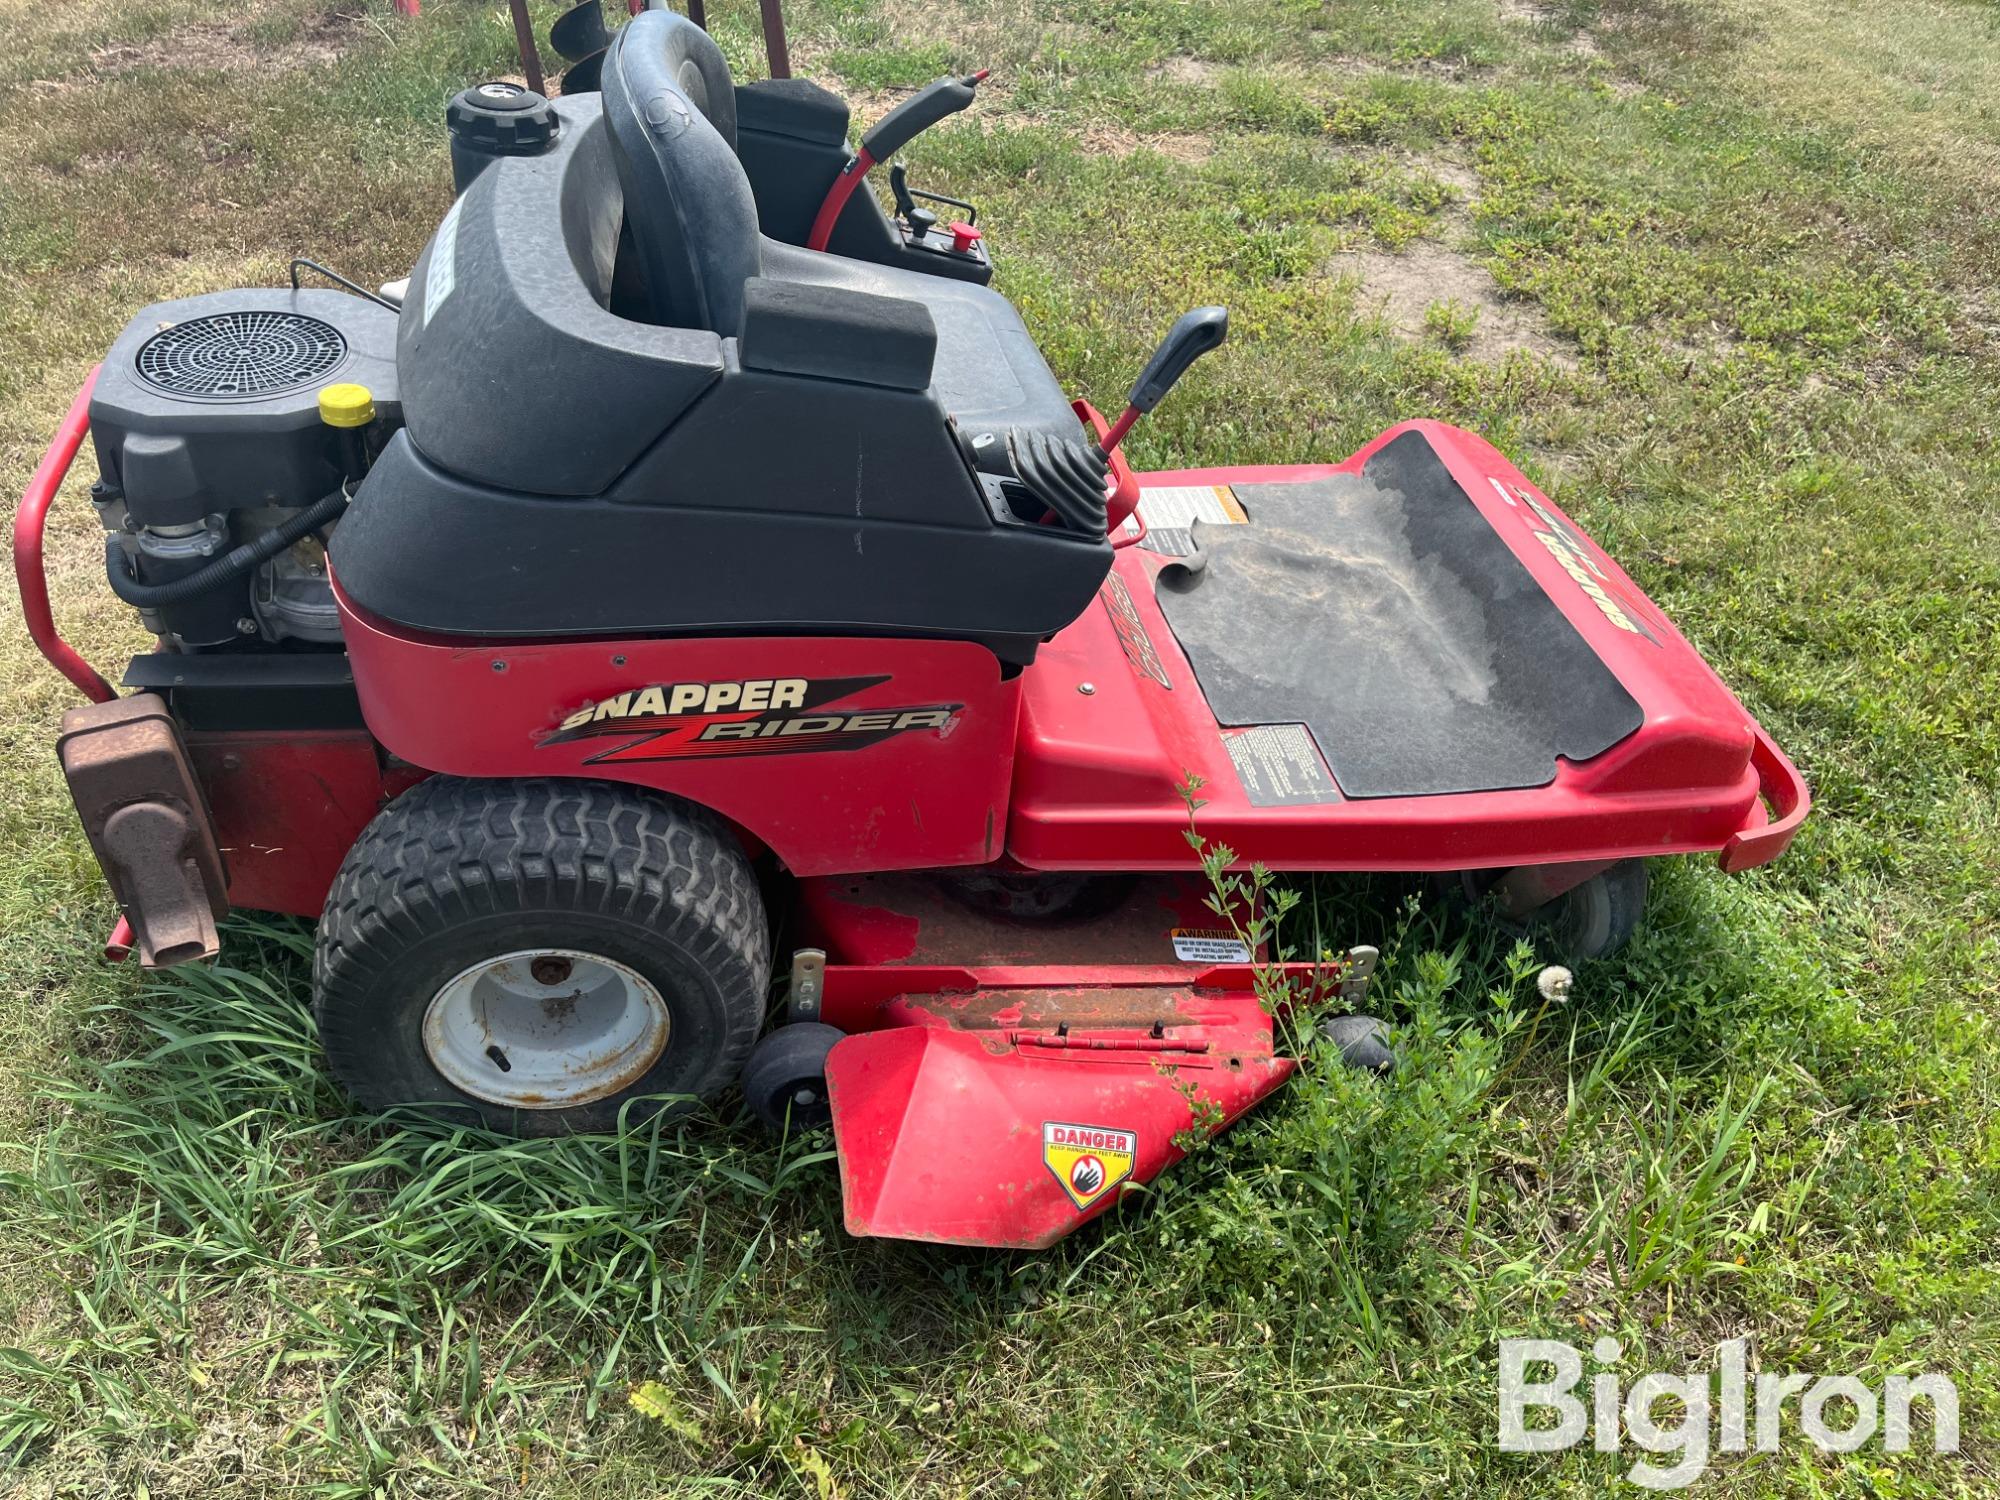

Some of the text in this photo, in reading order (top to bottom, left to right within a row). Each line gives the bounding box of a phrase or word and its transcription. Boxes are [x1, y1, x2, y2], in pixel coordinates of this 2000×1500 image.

[1534, 531, 1639, 634] SNAPPER
[559, 678, 808, 731] SNAPPER
[700, 710, 951, 740] RIDER
[1053, 1128, 1127, 1150] DANGER
